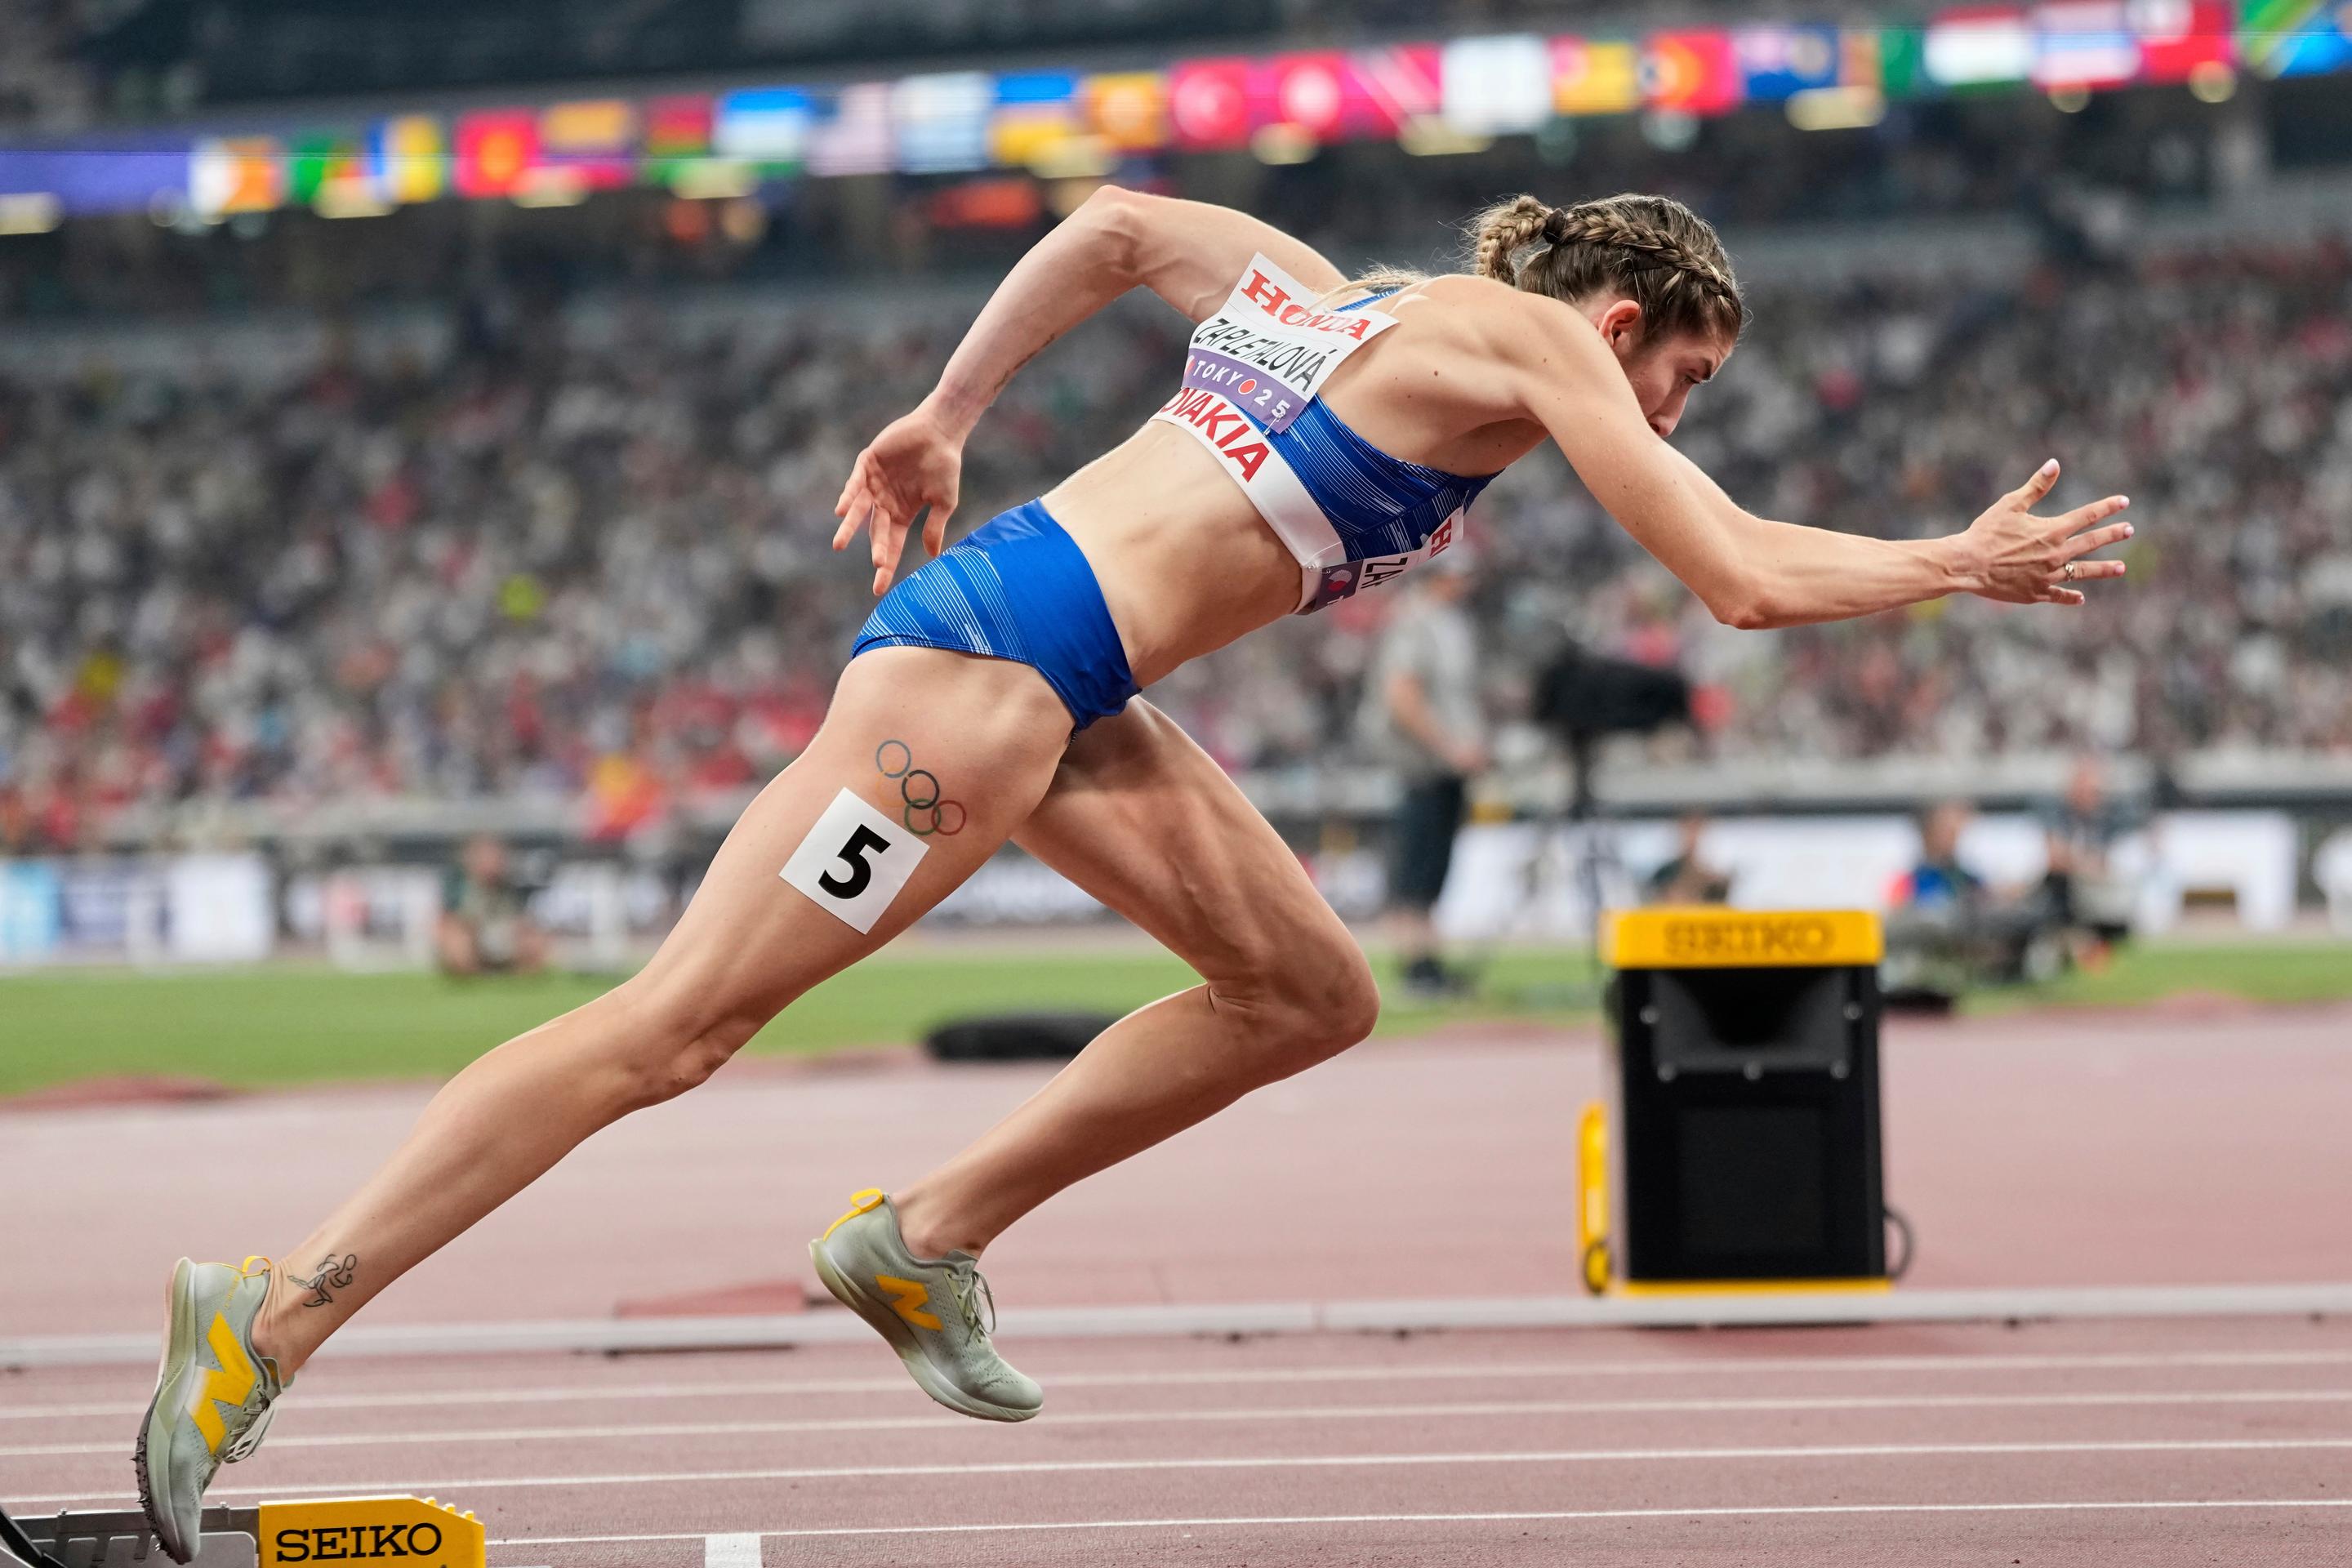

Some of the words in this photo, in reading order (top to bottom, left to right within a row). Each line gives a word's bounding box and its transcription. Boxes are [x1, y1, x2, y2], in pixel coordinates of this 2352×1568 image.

[1241, 269, 1371, 341] HONDA
[1192, 318, 1339, 393] ZAPLETALOVÁ
[1429, 517, 1453, 558] H
[1361, 556, 1409, 590] ZA
[817, 823, 892, 900] 5
[1664, 918, 1836, 959] SEIKO
[275, 1521, 443, 1562] SEIKO
